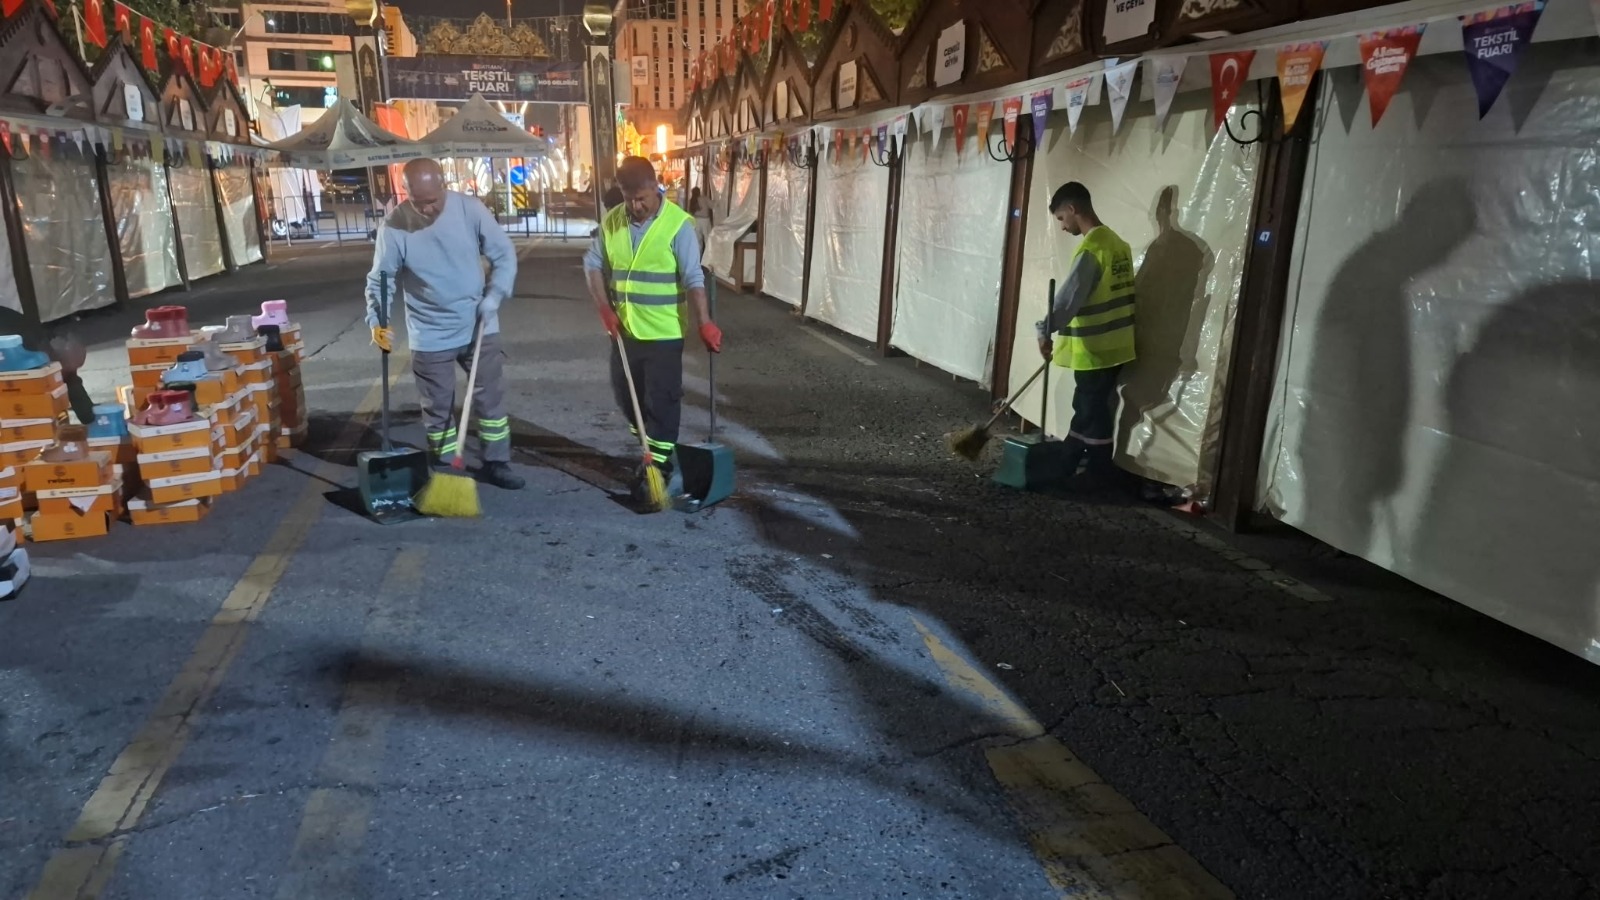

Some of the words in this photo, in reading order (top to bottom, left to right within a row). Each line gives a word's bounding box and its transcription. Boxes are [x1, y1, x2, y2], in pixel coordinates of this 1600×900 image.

[1473, 27, 1519, 48] TEKSTİL
[1477, 43, 1513, 59] FUARI
[461, 68, 515, 82] TEKSTİL
[469, 81, 509, 93] FUARI
